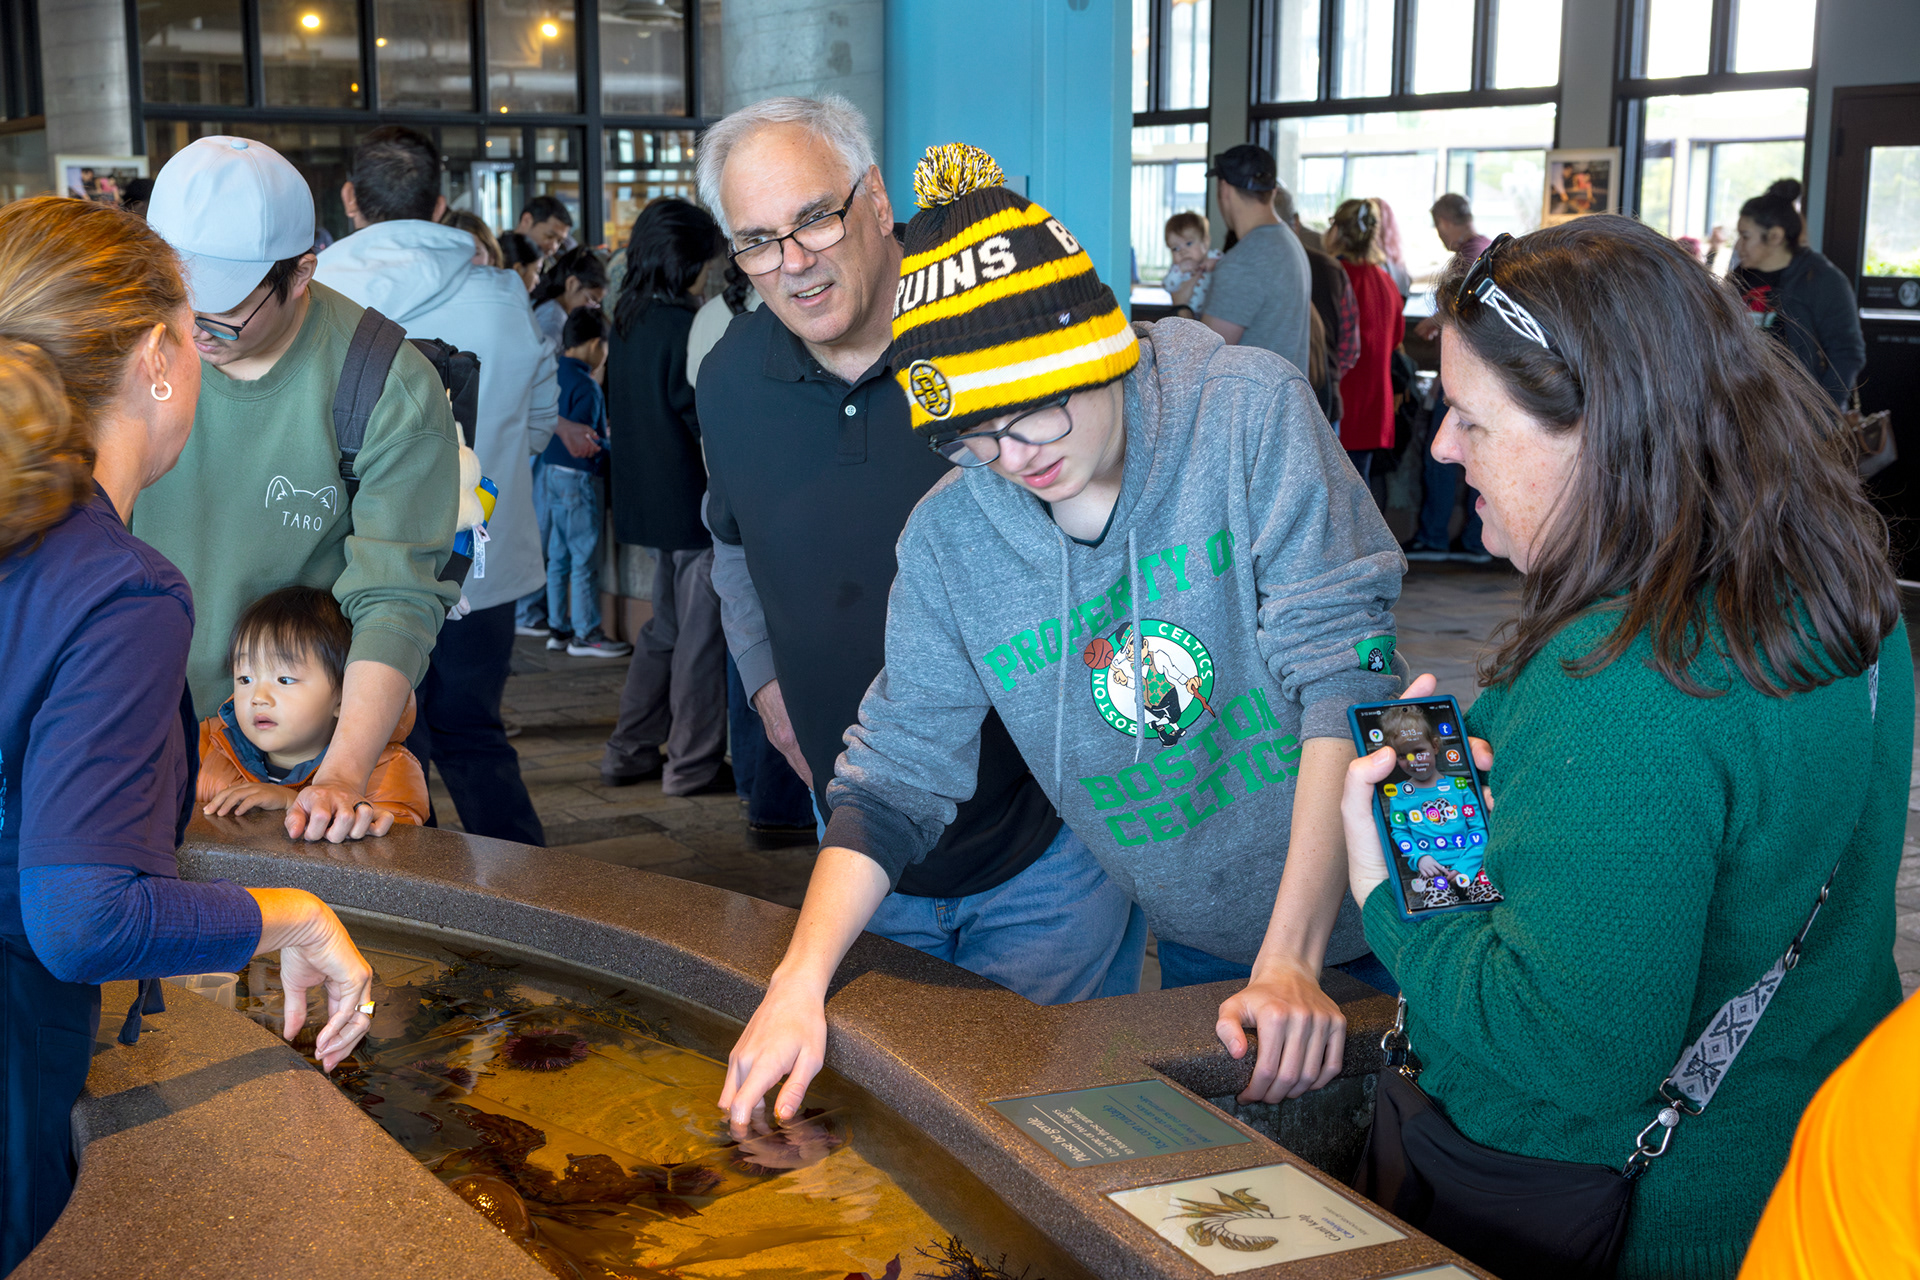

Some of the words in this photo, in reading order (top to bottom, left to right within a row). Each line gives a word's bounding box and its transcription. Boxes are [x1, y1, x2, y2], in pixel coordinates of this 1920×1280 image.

[282, 510, 323, 532] TARO
[1205, 528, 1235, 577] O
[1159, 623, 1213, 680] CELTICS
[1093, 673, 1138, 735] BOSTON
[1400, 728, 1417, 737] 3:13
[1079, 687, 1282, 810] BOSTON
[1105, 733, 1303, 847] CELTICS
[1051, 1109, 1076, 1125] fingers
[1026, 1117, 1061, 1135] gentle
[1071, 1123, 1088, 1133] two
[1089, 1123, 1110, 1137] these
[1050, 1134, 1067, 1144] be
[1090, 1137, 1107, 1148] one
[1104, 1135, 1128, 1150] touch
[1060, 1142, 1091, 1163] Please
[1101, 1145, 1120, 1157] Use
[1298, 1214, 1319, 1227] kelp
[1314, 1225, 1342, 1242] Giant
